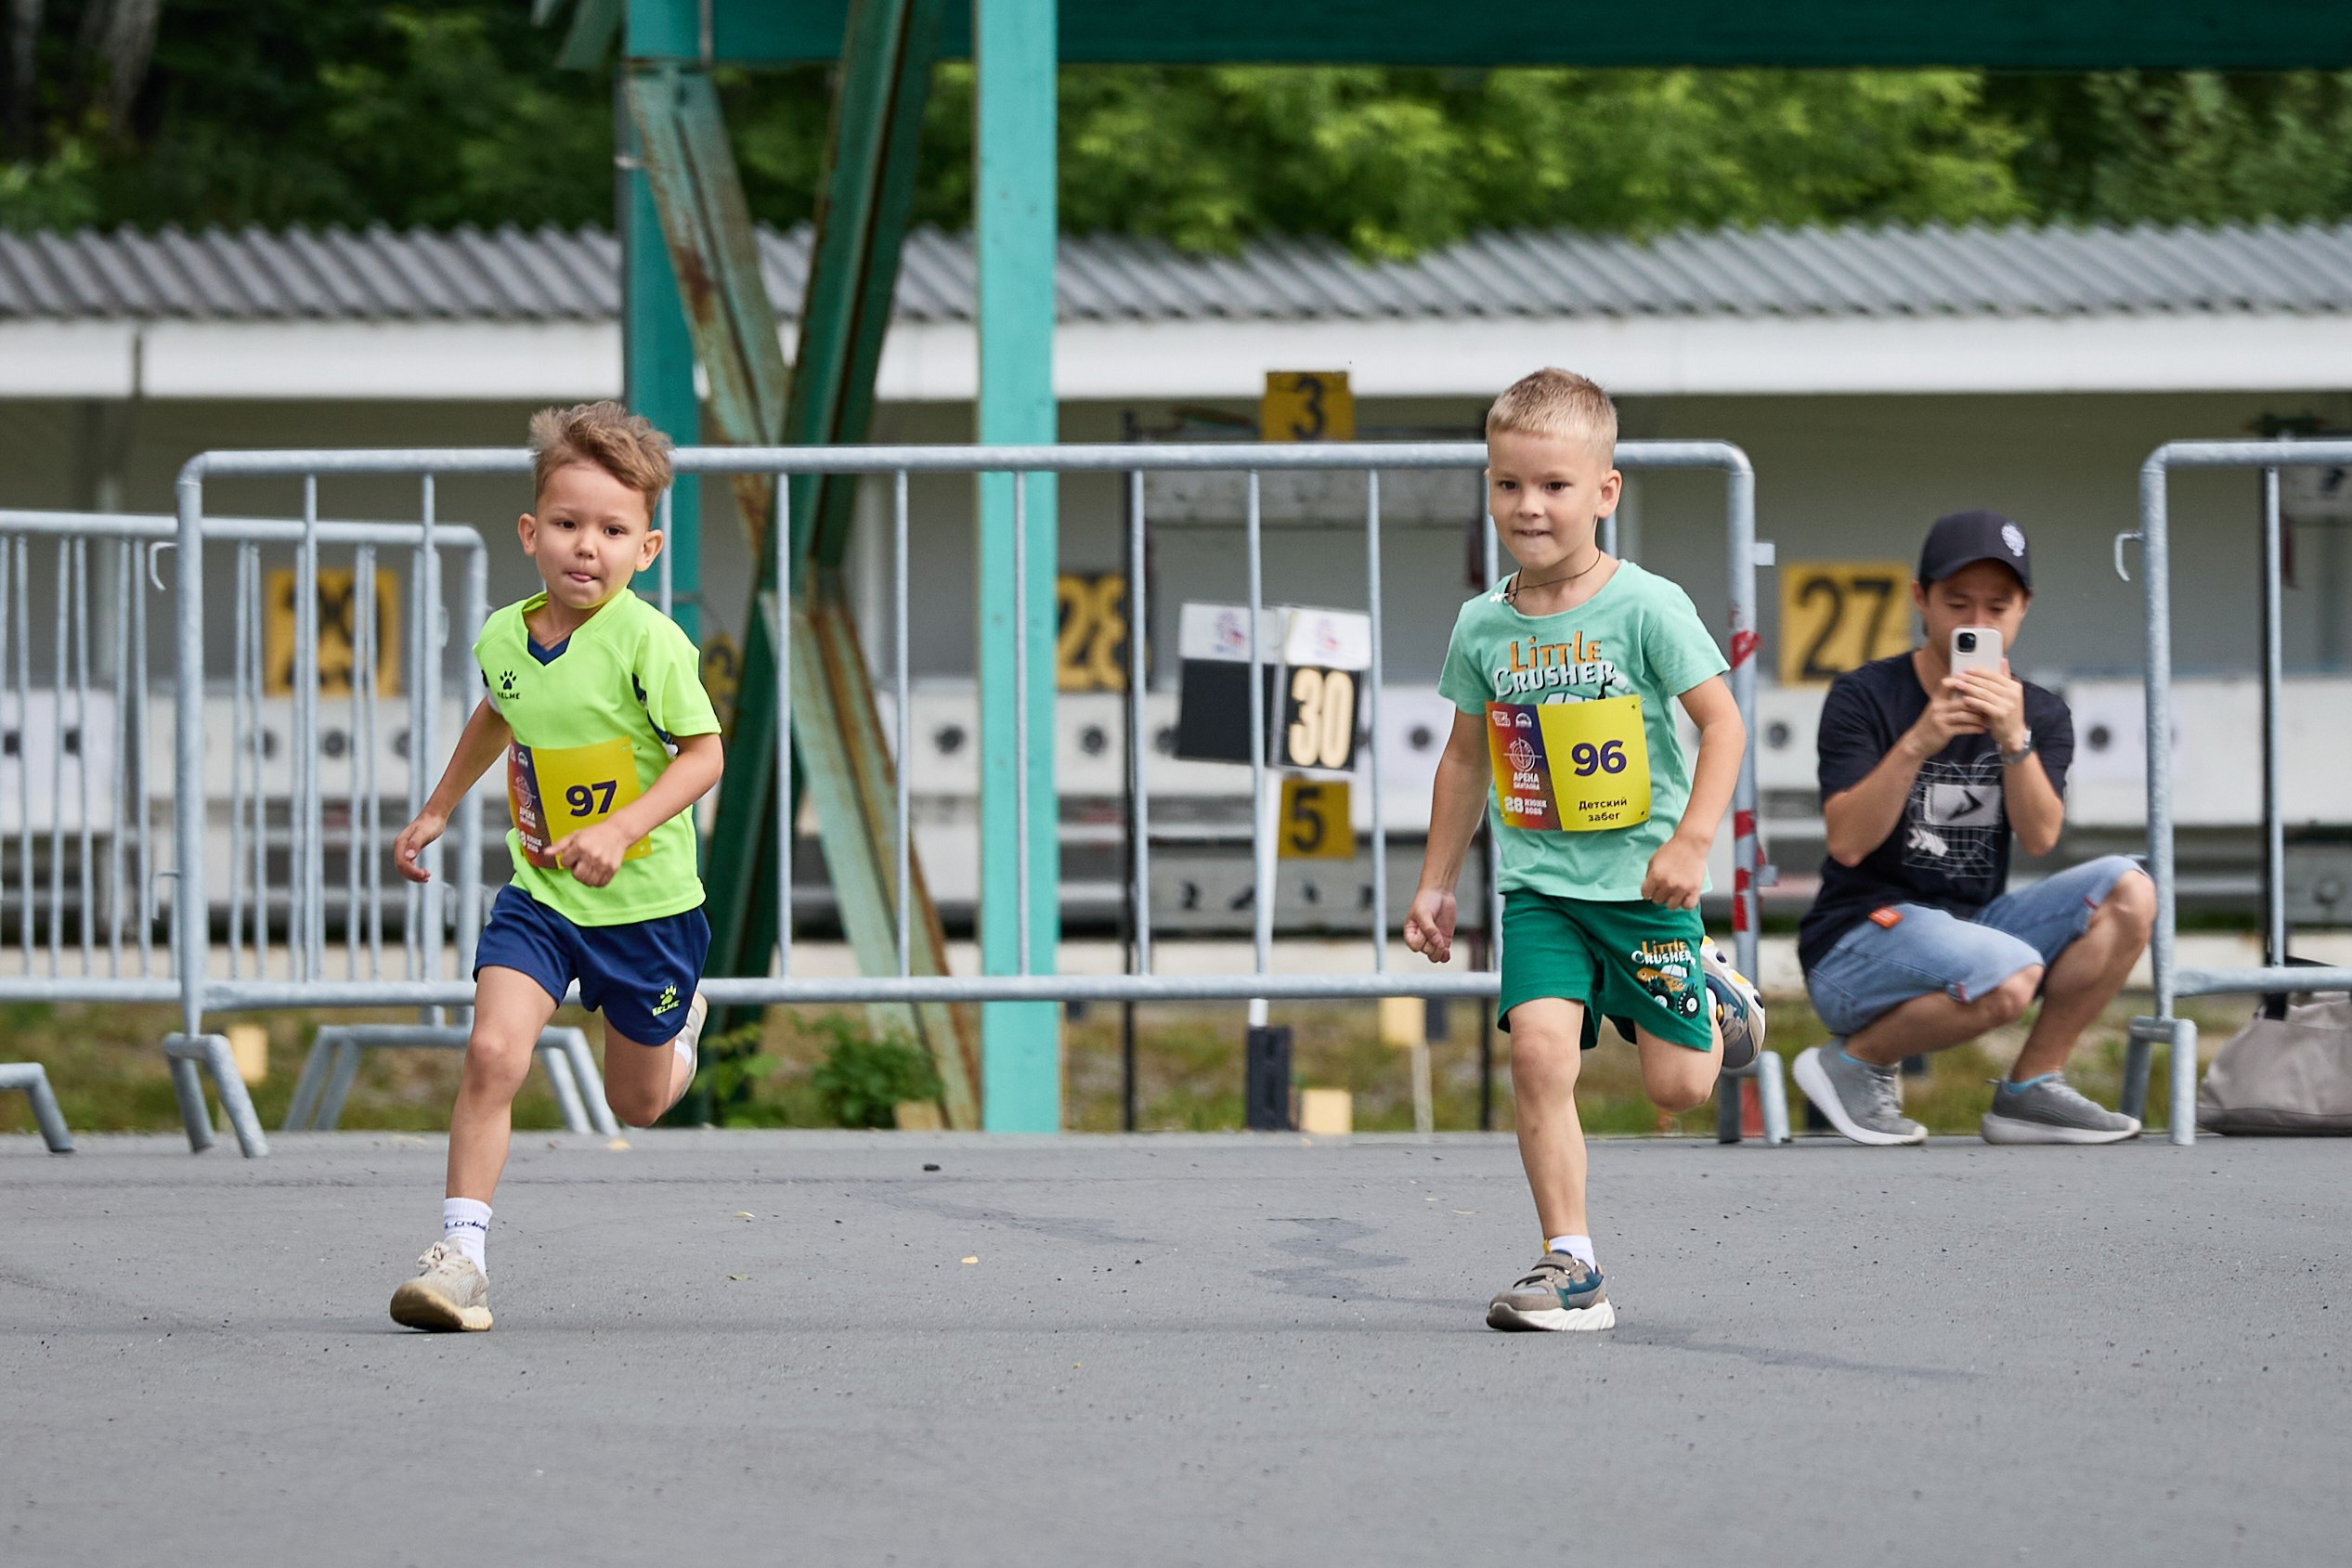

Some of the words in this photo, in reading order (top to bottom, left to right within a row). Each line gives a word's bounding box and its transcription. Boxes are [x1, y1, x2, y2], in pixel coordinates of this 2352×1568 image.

[1292, 375, 1325, 441] 3
[1798, 576, 1893, 680] 27
[1493, 660, 1617, 697] CRUSHER
[1288, 667, 1354, 769] 30
[1571, 740, 1627, 777] 96
[1513, 771, 1540, 784] АРЕНА
[565, 780, 617, 817] 97
[1504, 796, 1524, 813] 28
[1579, 797, 1628, 811] Детский
[1588, 812, 1620, 822] забег
[1291, 784, 1327, 853] 5
[1631, 950, 1693, 965] CRUSHER
